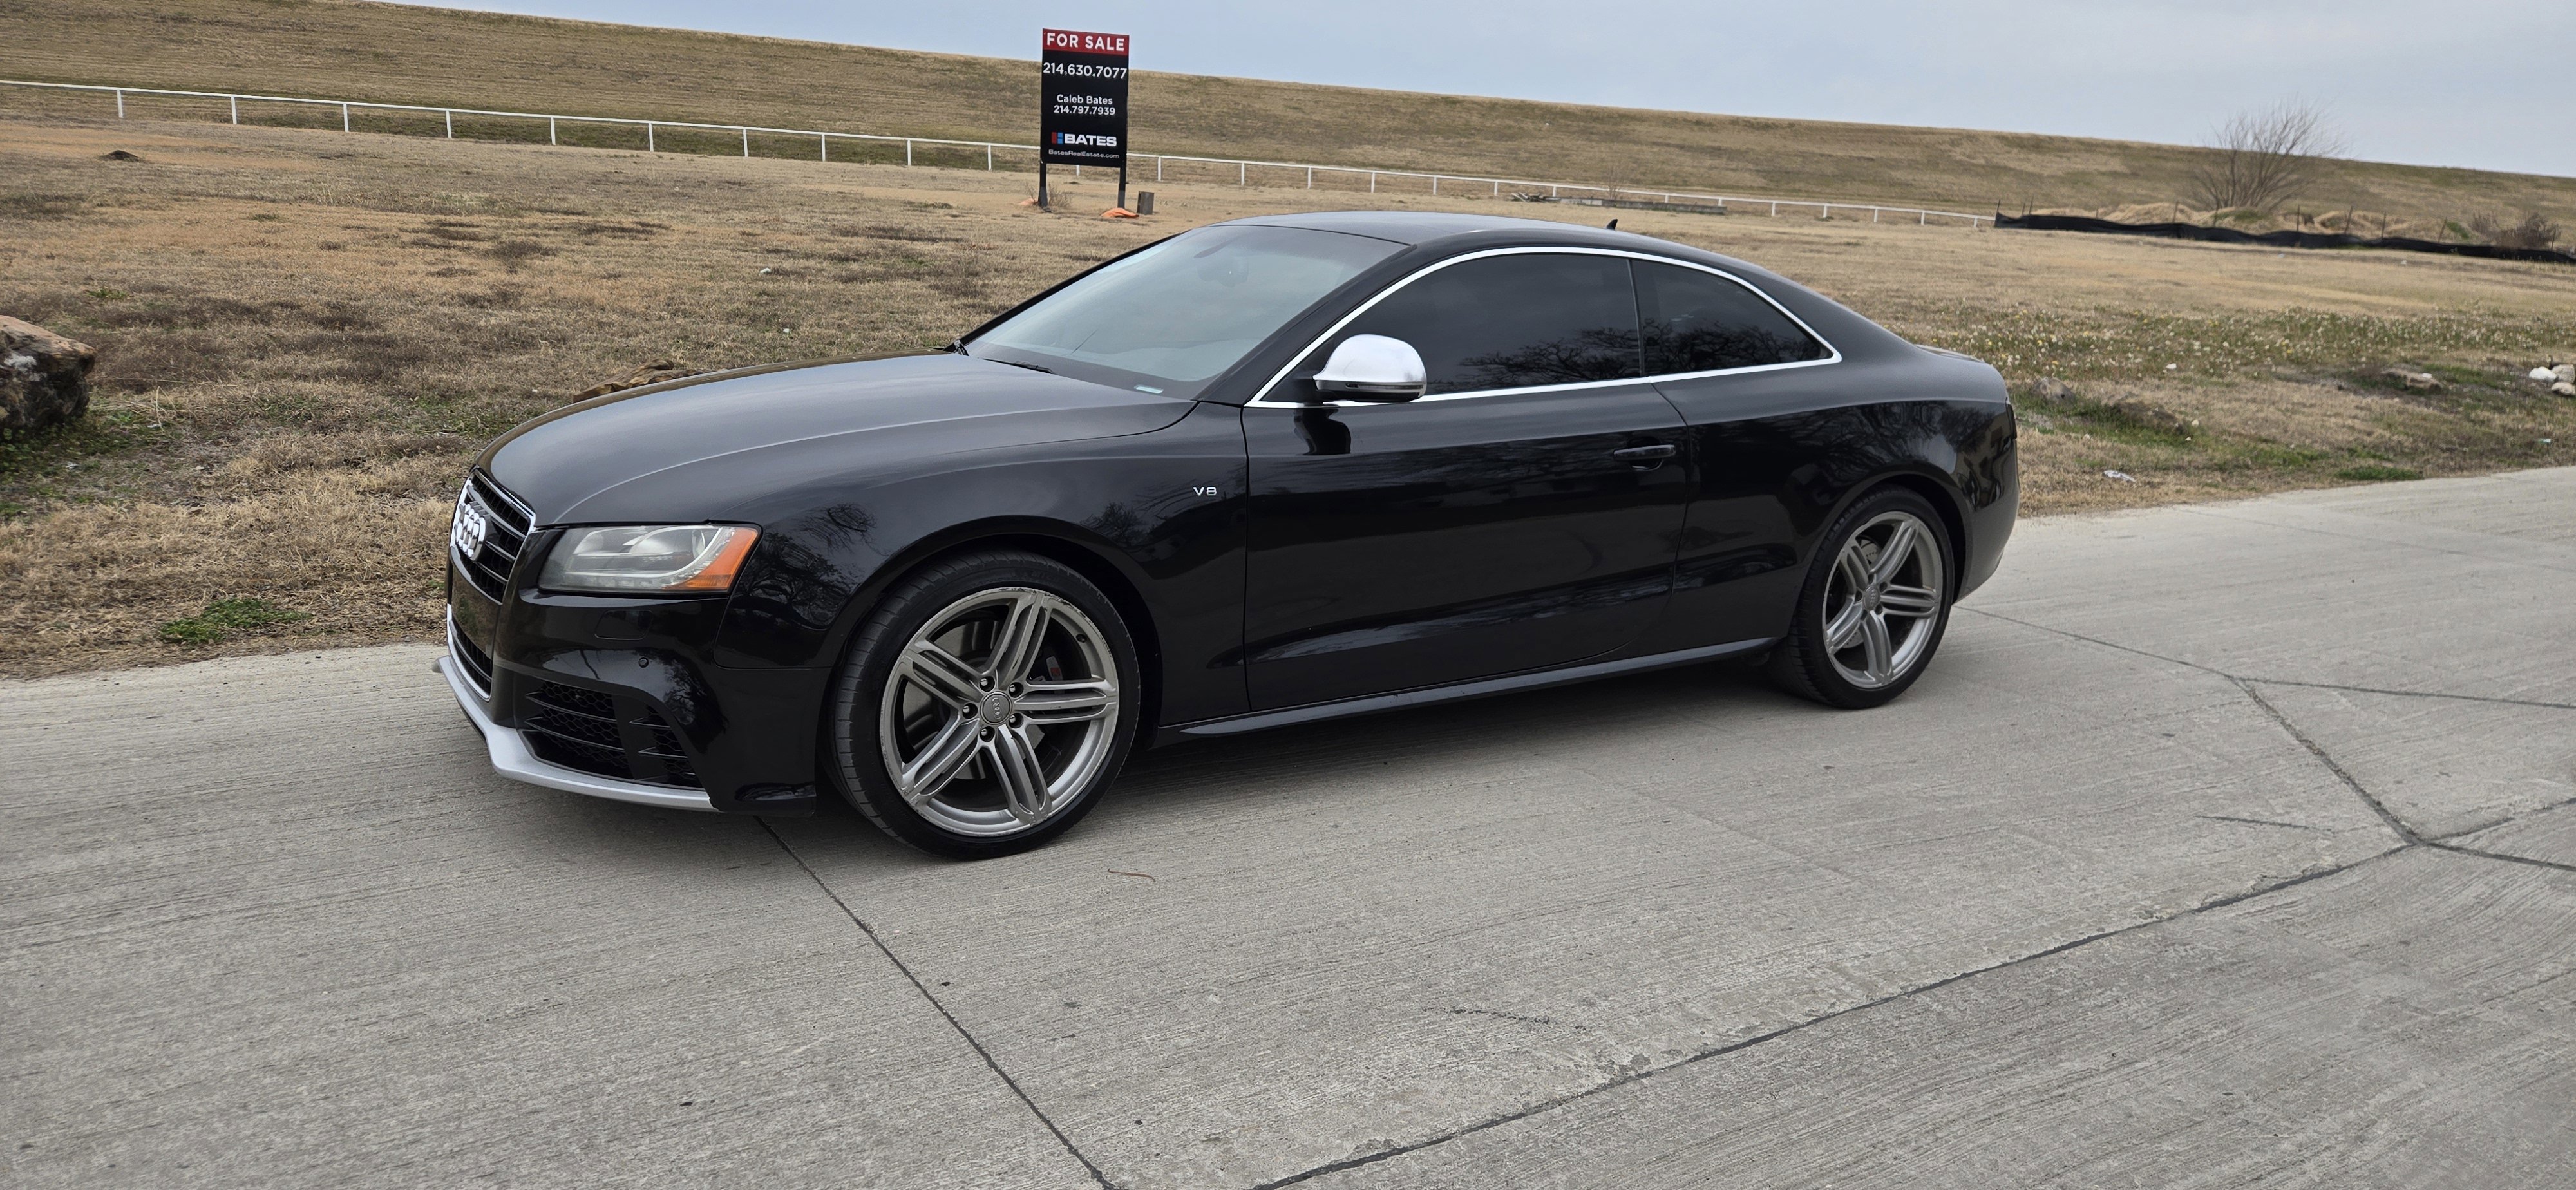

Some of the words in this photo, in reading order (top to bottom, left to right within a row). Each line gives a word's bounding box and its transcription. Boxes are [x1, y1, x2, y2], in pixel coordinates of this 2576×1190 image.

[1046, 32, 1079, 48] FOR
[1085, 35, 1124, 52] SALE
[1043, 62, 1127, 79] 214.630.7077
[1056, 94, 1084, 103] Caleb
[1086, 95, 1113, 105] Bates
[1054, 105, 1115, 115] 214.797.7939
[1064, 133, 1117, 147] BATES
[1048, 149, 1119, 158] BatesRealEstate.com
[1193, 486, 1217, 496] V8
